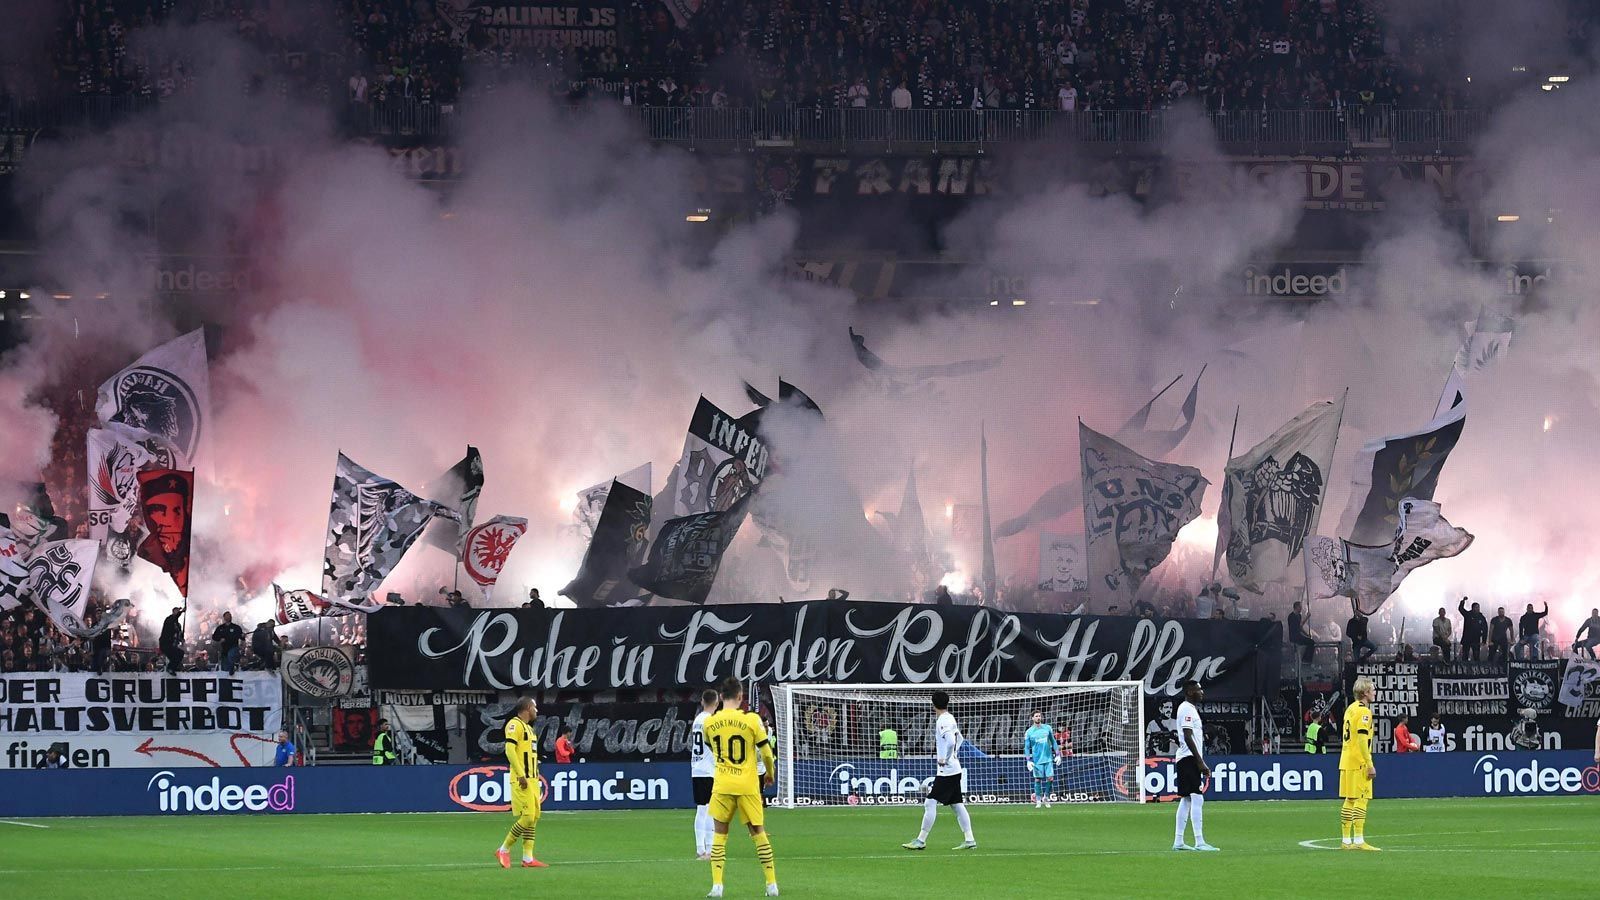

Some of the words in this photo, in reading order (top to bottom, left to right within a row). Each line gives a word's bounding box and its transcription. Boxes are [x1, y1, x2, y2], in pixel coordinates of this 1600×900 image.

[485, 29, 617, 48] SCHAFFENBURG
[1246, 268, 1347, 295] indeed
[418, 609, 600, 690] Ruhe
[610, 635, 656, 689] in
[659, 604, 861, 687] Frieden
[845, 605, 1020, 684] Rolf
[1029, 616, 1227, 697] Heller
[1356, 663, 1386, 674] EHRE
[1395, 662, 1419, 675] DER
[0, 679, 60, 703] ER
[85, 678, 244, 704] GRUPPE
[1358, 675, 1418, 690] RUPPE
[1436, 681, 1508, 697] FRANKFURT
[385, 692, 426, 705] NUOVA
[1374, 690, 1419, 703] ADION
[1437, 700, 1508, 715] HOOLIGANS
[1369, 703, 1419, 717] ERBOT
[476, 702, 697, 755] Entrach
[710, 719, 748, 732] DORTMUND
[692, 731, 704, 756] 9
[1463, 724, 1562, 750] finn
[712, 734, 747, 765] 10
[838, 767, 968, 795] inde
[1212, 761, 1324, 793] finden
[1482, 759, 1600, 793] indeed
[157, 774, 294, 812] indeed
[461, 774, 543, 803] Jo
[861, 796, 874, 804] LG
[878, 795, 906, 804] OLED
[968, 794, 997, 803] OLED
[766, 797, 779, 805] LG
[783, 797, 811, 805] OED
